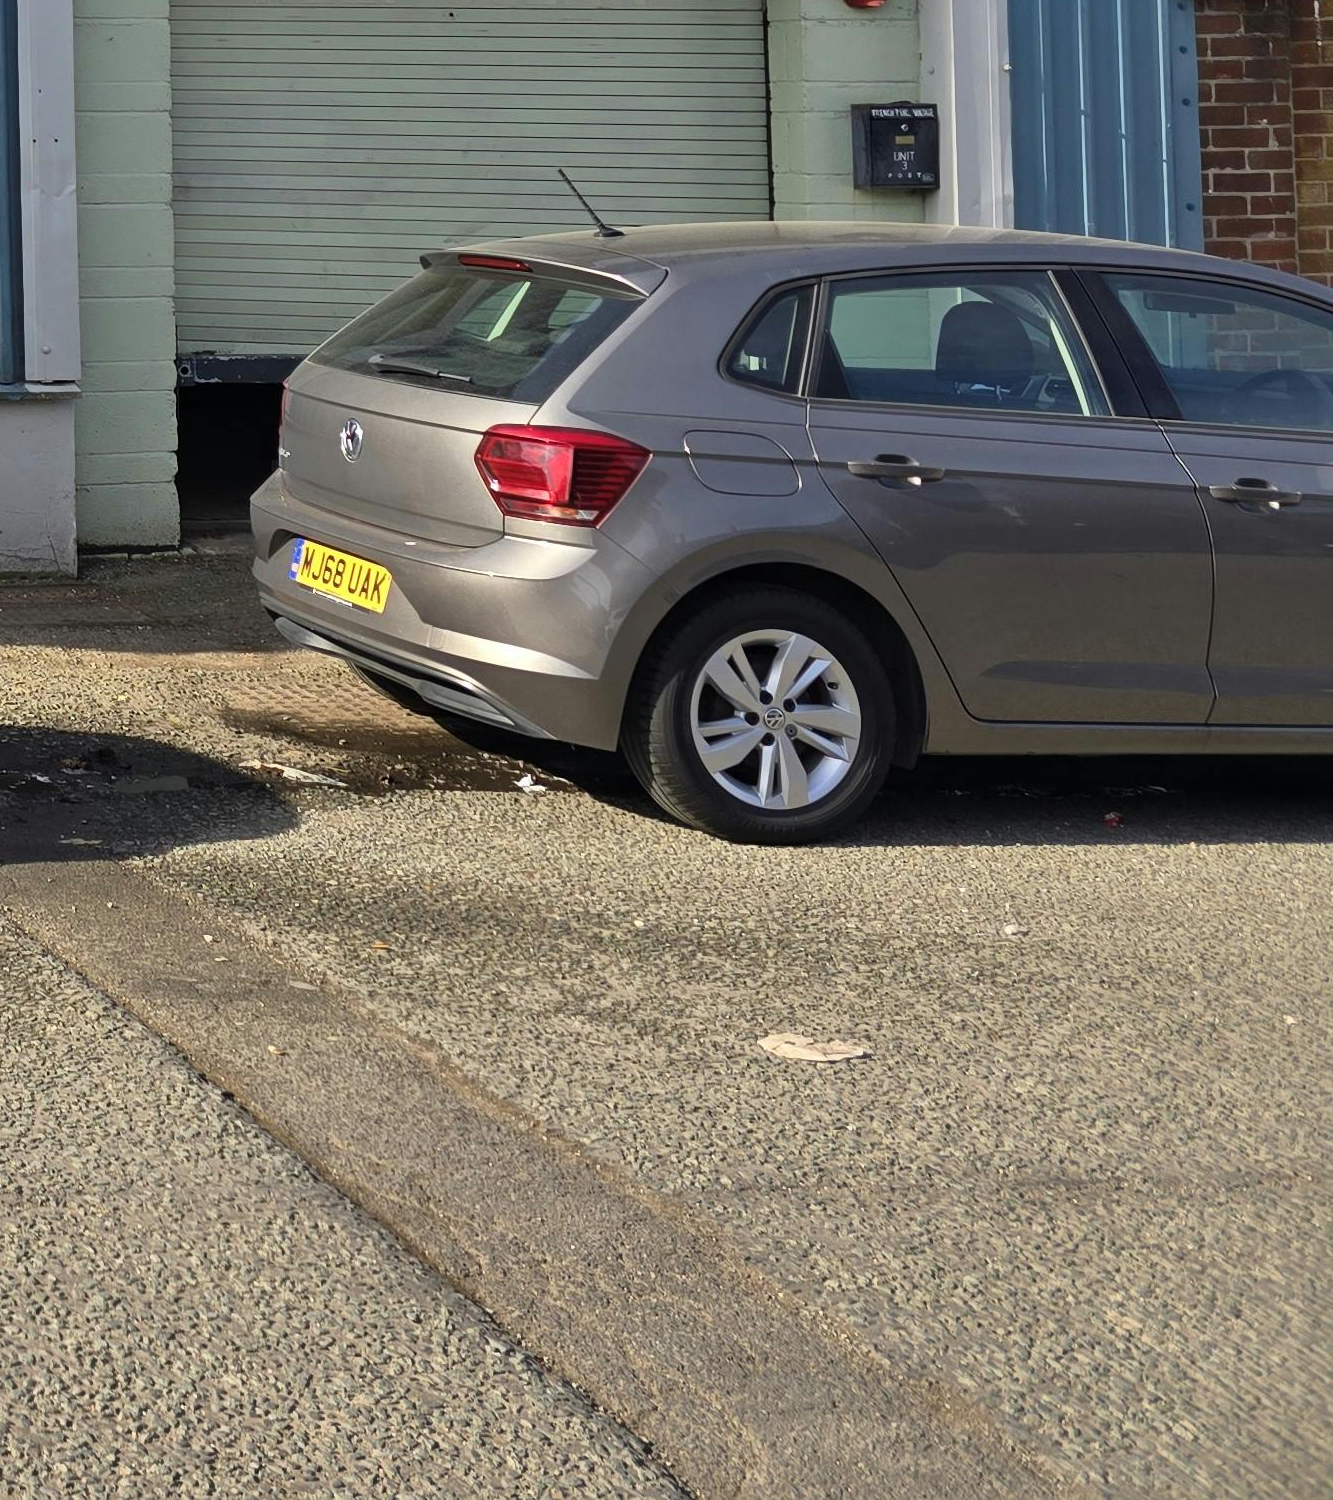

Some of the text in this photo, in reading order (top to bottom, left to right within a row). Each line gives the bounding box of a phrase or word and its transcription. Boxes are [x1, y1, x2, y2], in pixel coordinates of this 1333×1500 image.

[893, 151, 915, 161] UNIT
[901, 160, 908, 170] 3
[300, 546, 347, 589] MJ68
[347, 563, 387, 604] UAK
